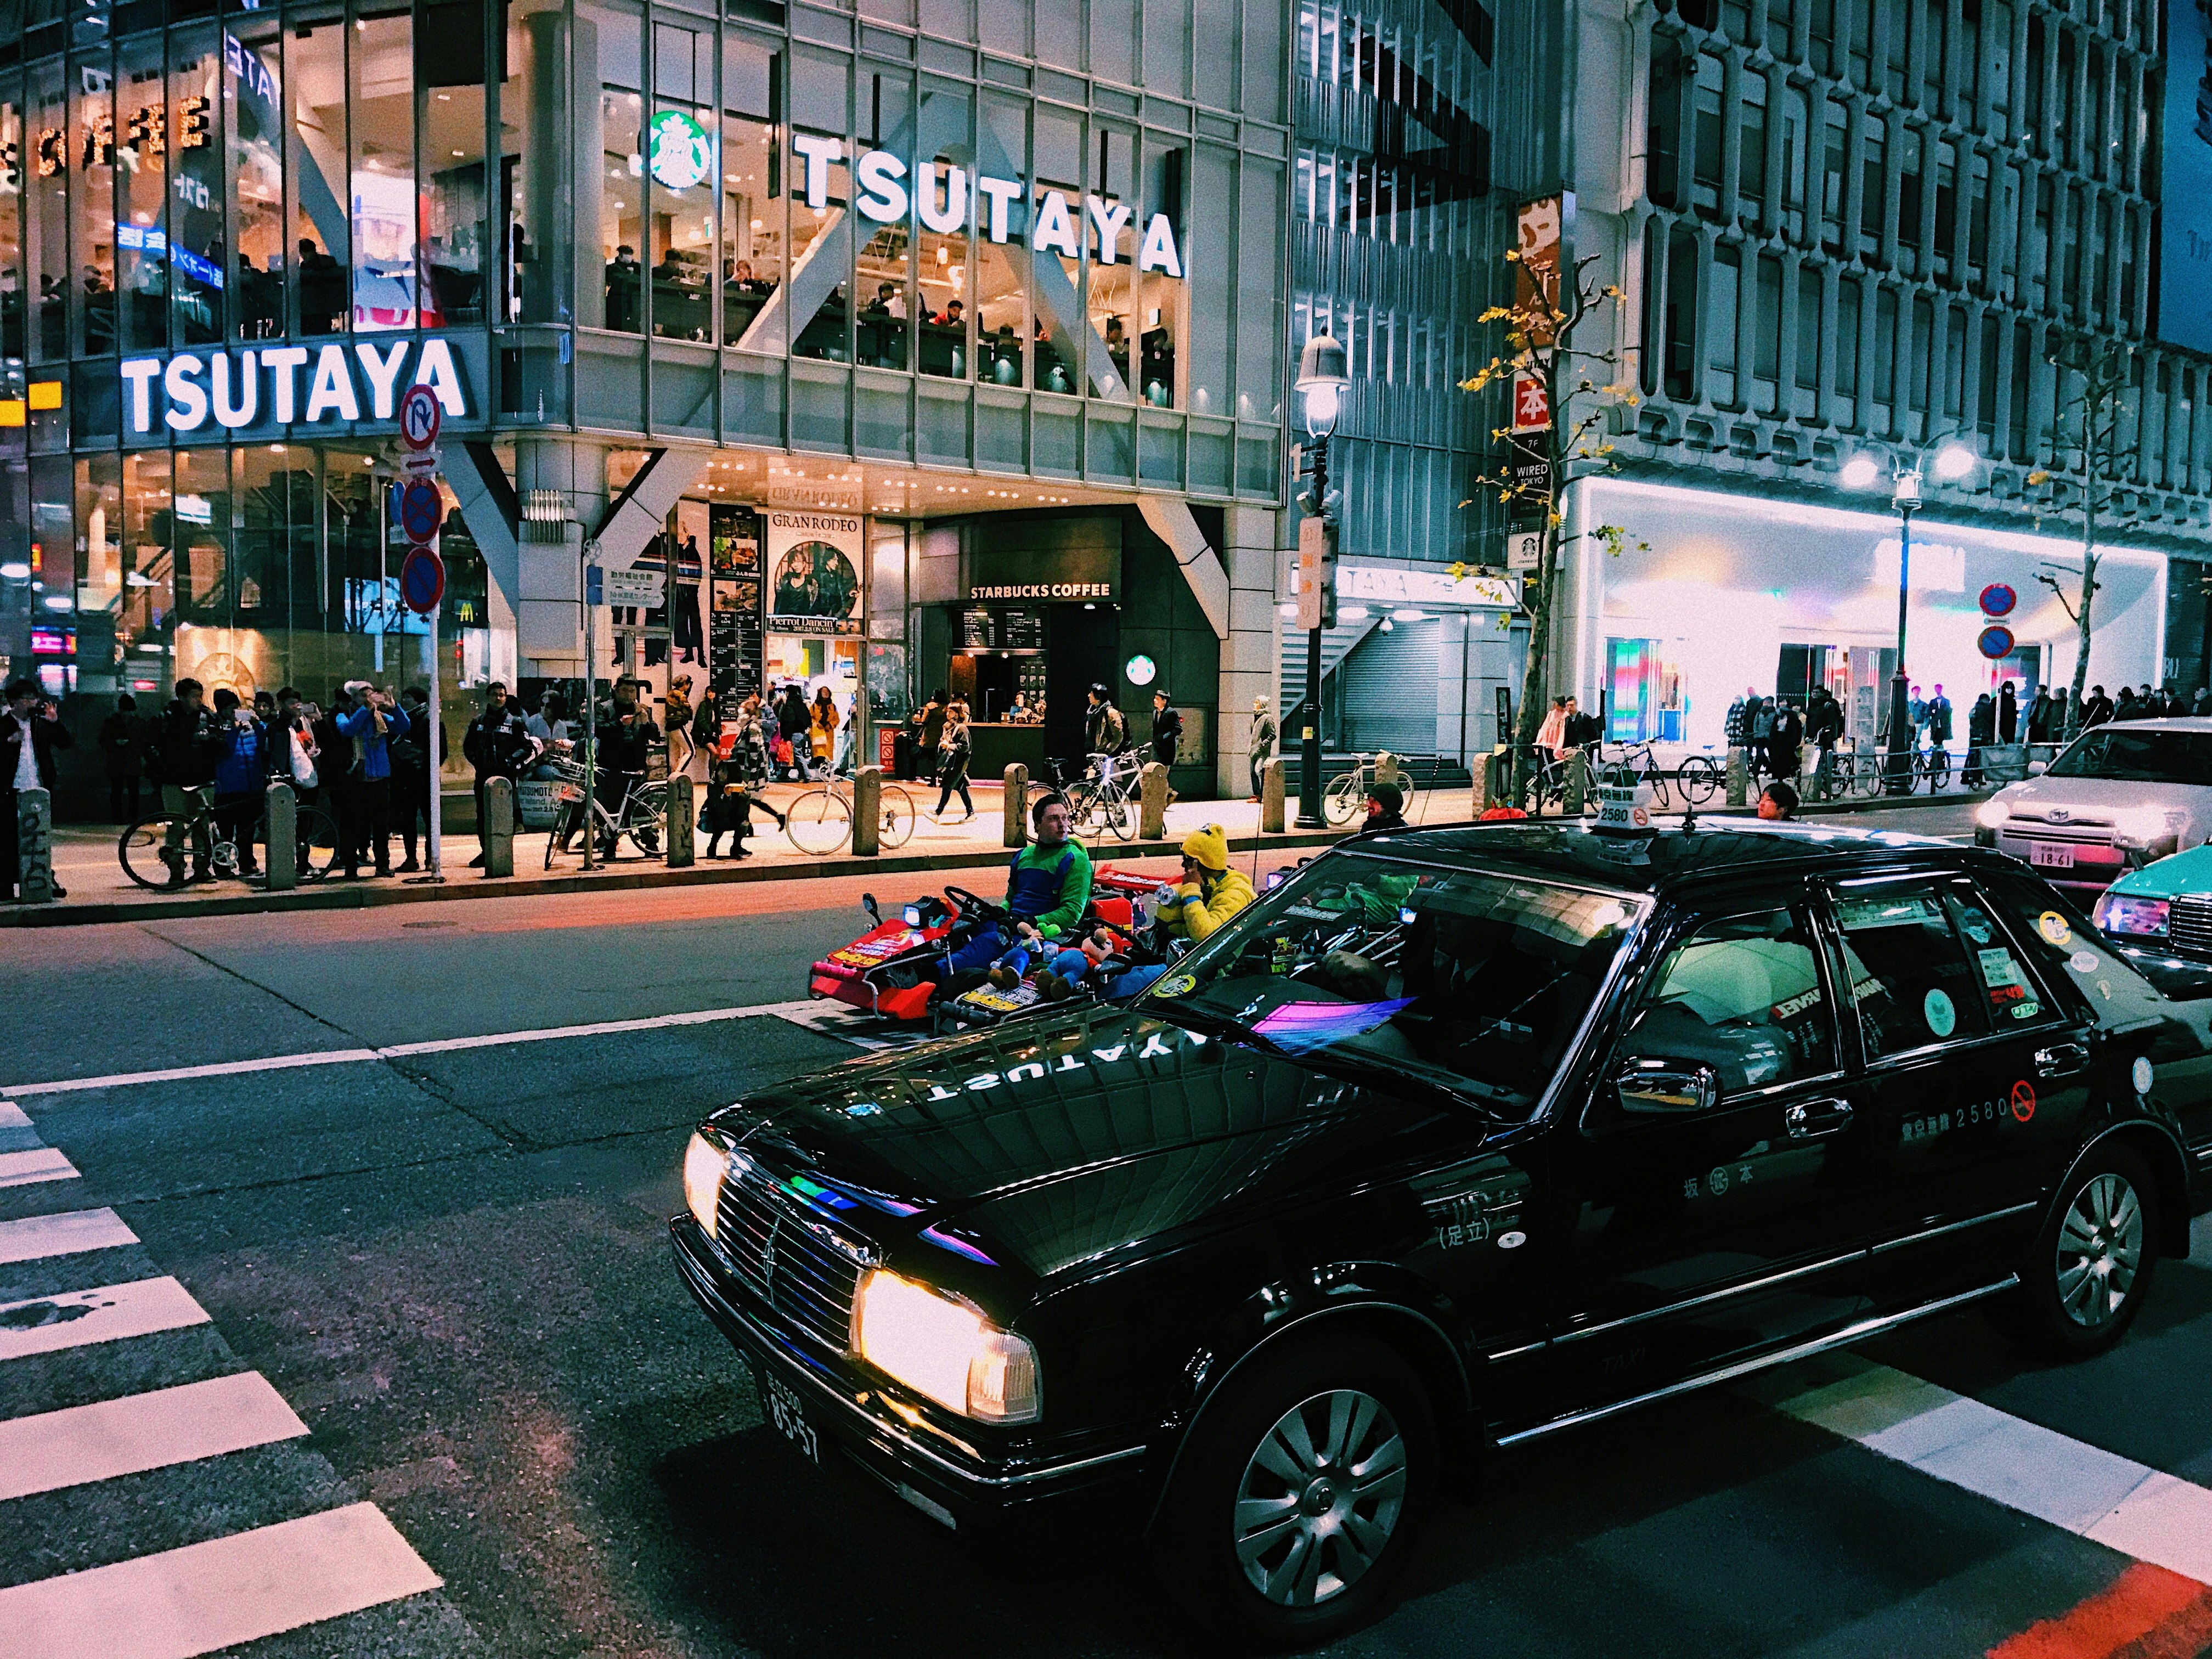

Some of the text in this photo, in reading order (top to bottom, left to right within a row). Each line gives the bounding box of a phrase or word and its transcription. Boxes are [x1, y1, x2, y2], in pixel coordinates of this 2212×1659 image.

[794, 135, 1182, 278] TSUTAYA
[120, 338, 466, 432] TSUTAYA
[1520, 387, 1548, 420] 本
[1516, 464, 1548, 477] WIRED
[1520, 476, 1544, 486] TOKYO
[772, 514, 857, 532] GRANRODEO
[970, 584, 1110, 599] STARBUCKS COFFEE
[769, 617, 799, 628] Pierrot
[1600, 808, 1628, 822] 2580
[1956, 1098, 2007, 1128] 2580
[1440, 1217, 1490, 1250] (足立)
[770, 1393, 819, 1464] 85-57
